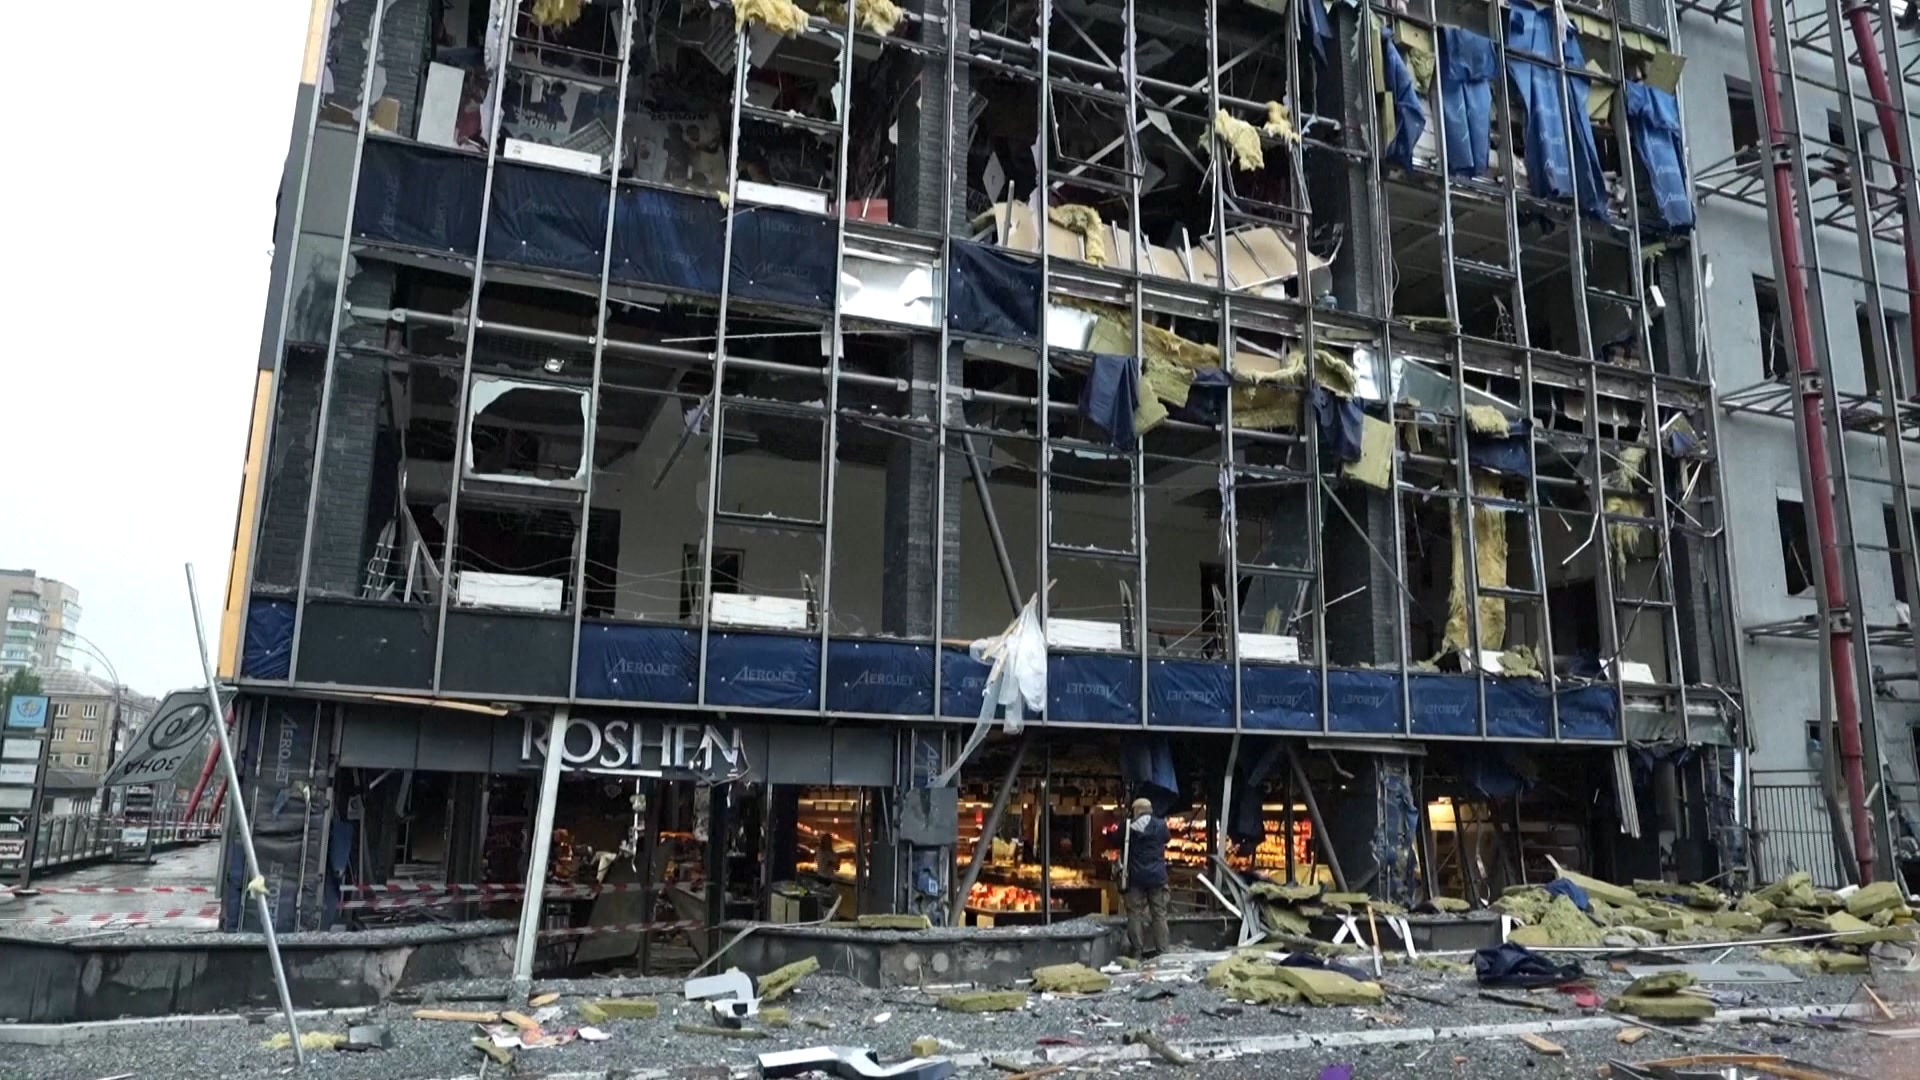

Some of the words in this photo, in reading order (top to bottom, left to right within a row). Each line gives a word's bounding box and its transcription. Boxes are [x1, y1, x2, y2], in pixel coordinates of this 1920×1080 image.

[608, 657, 678, 678] AEROJET
[730, 665, 798, 685] AEROJET
[850, 669, 915, 688] AEROJET
[276, 712, 298, 786] AEROJET
[519, 712, 744, 772] ROSHEN
[124, 755, 182, 777] ЗОНА
